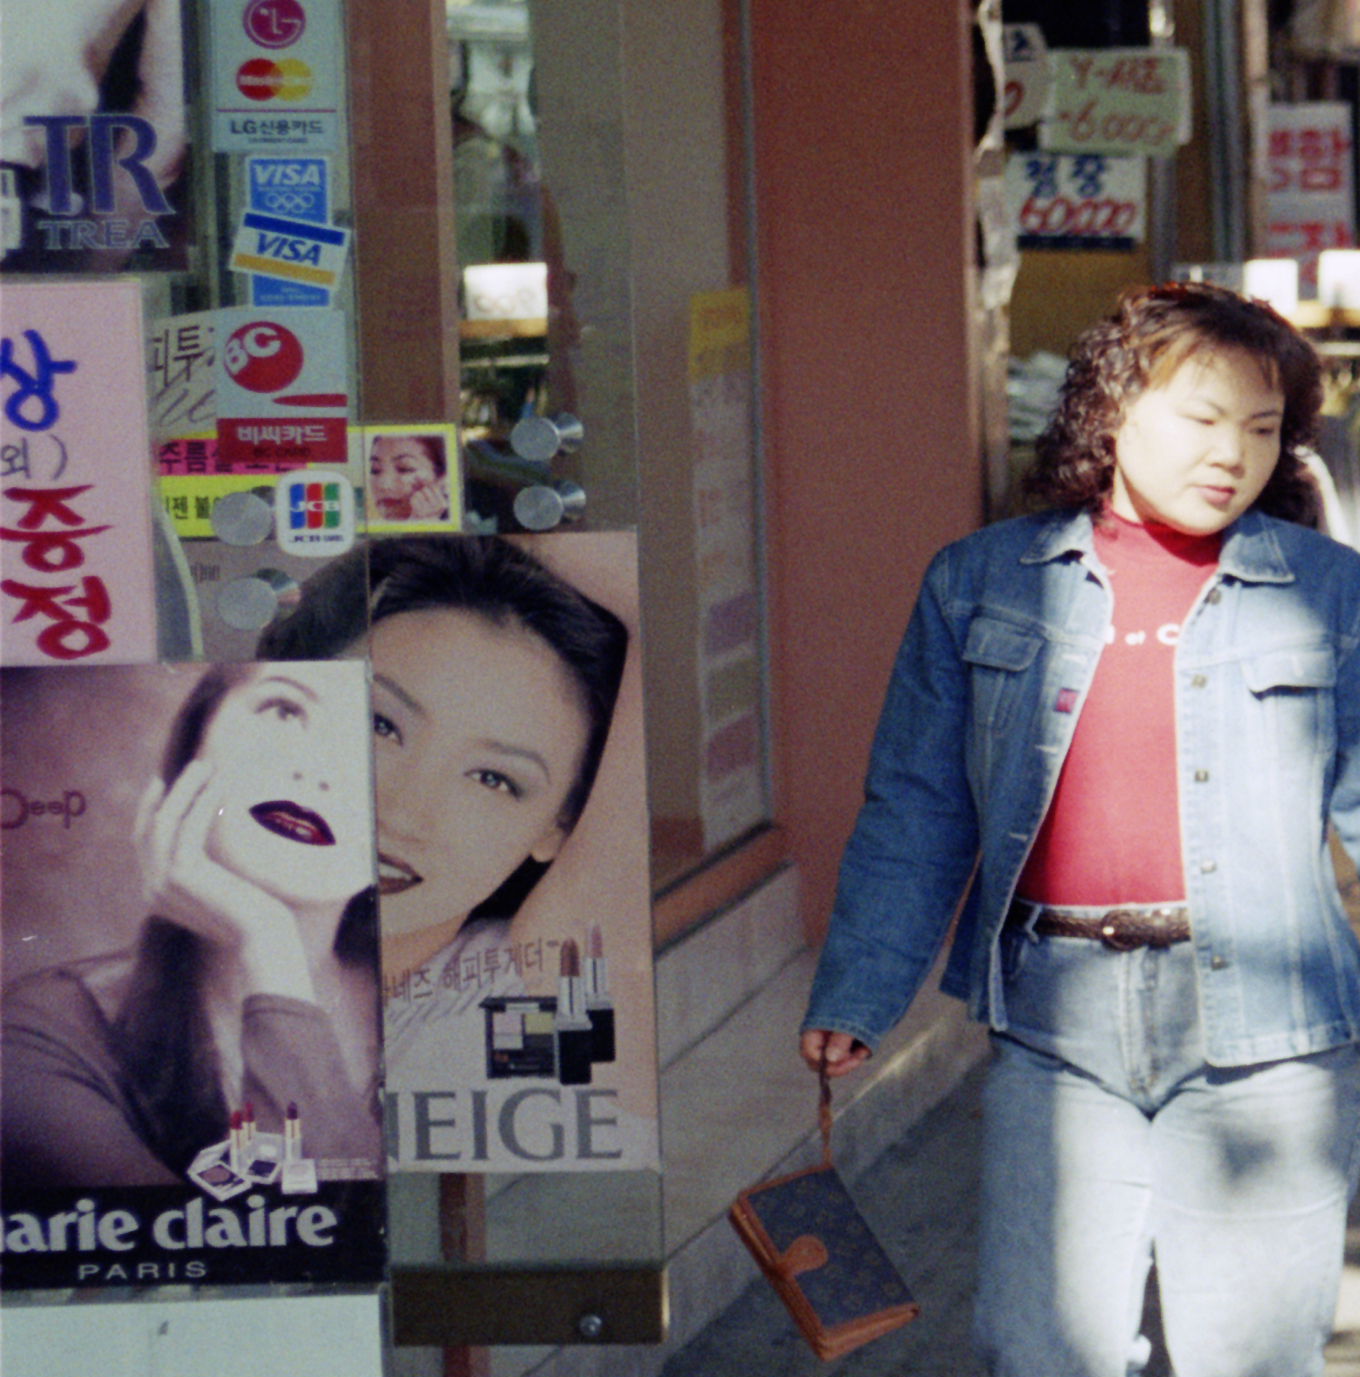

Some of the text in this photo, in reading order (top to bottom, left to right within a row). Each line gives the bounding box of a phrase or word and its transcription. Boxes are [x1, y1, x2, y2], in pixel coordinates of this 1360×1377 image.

[23, 115, 176, 215] TR
[254, 165, 320, 185] VISA
[37, 220, 170, 249] TREA
[257, 233, 321, 265] VISA
[225, 327, 281, 375] BC
[238, 426, 327, 444] 비씨카드
[153, 1195, 338, 1251] claire
[78, 1261, 208, 1280] PARIS
